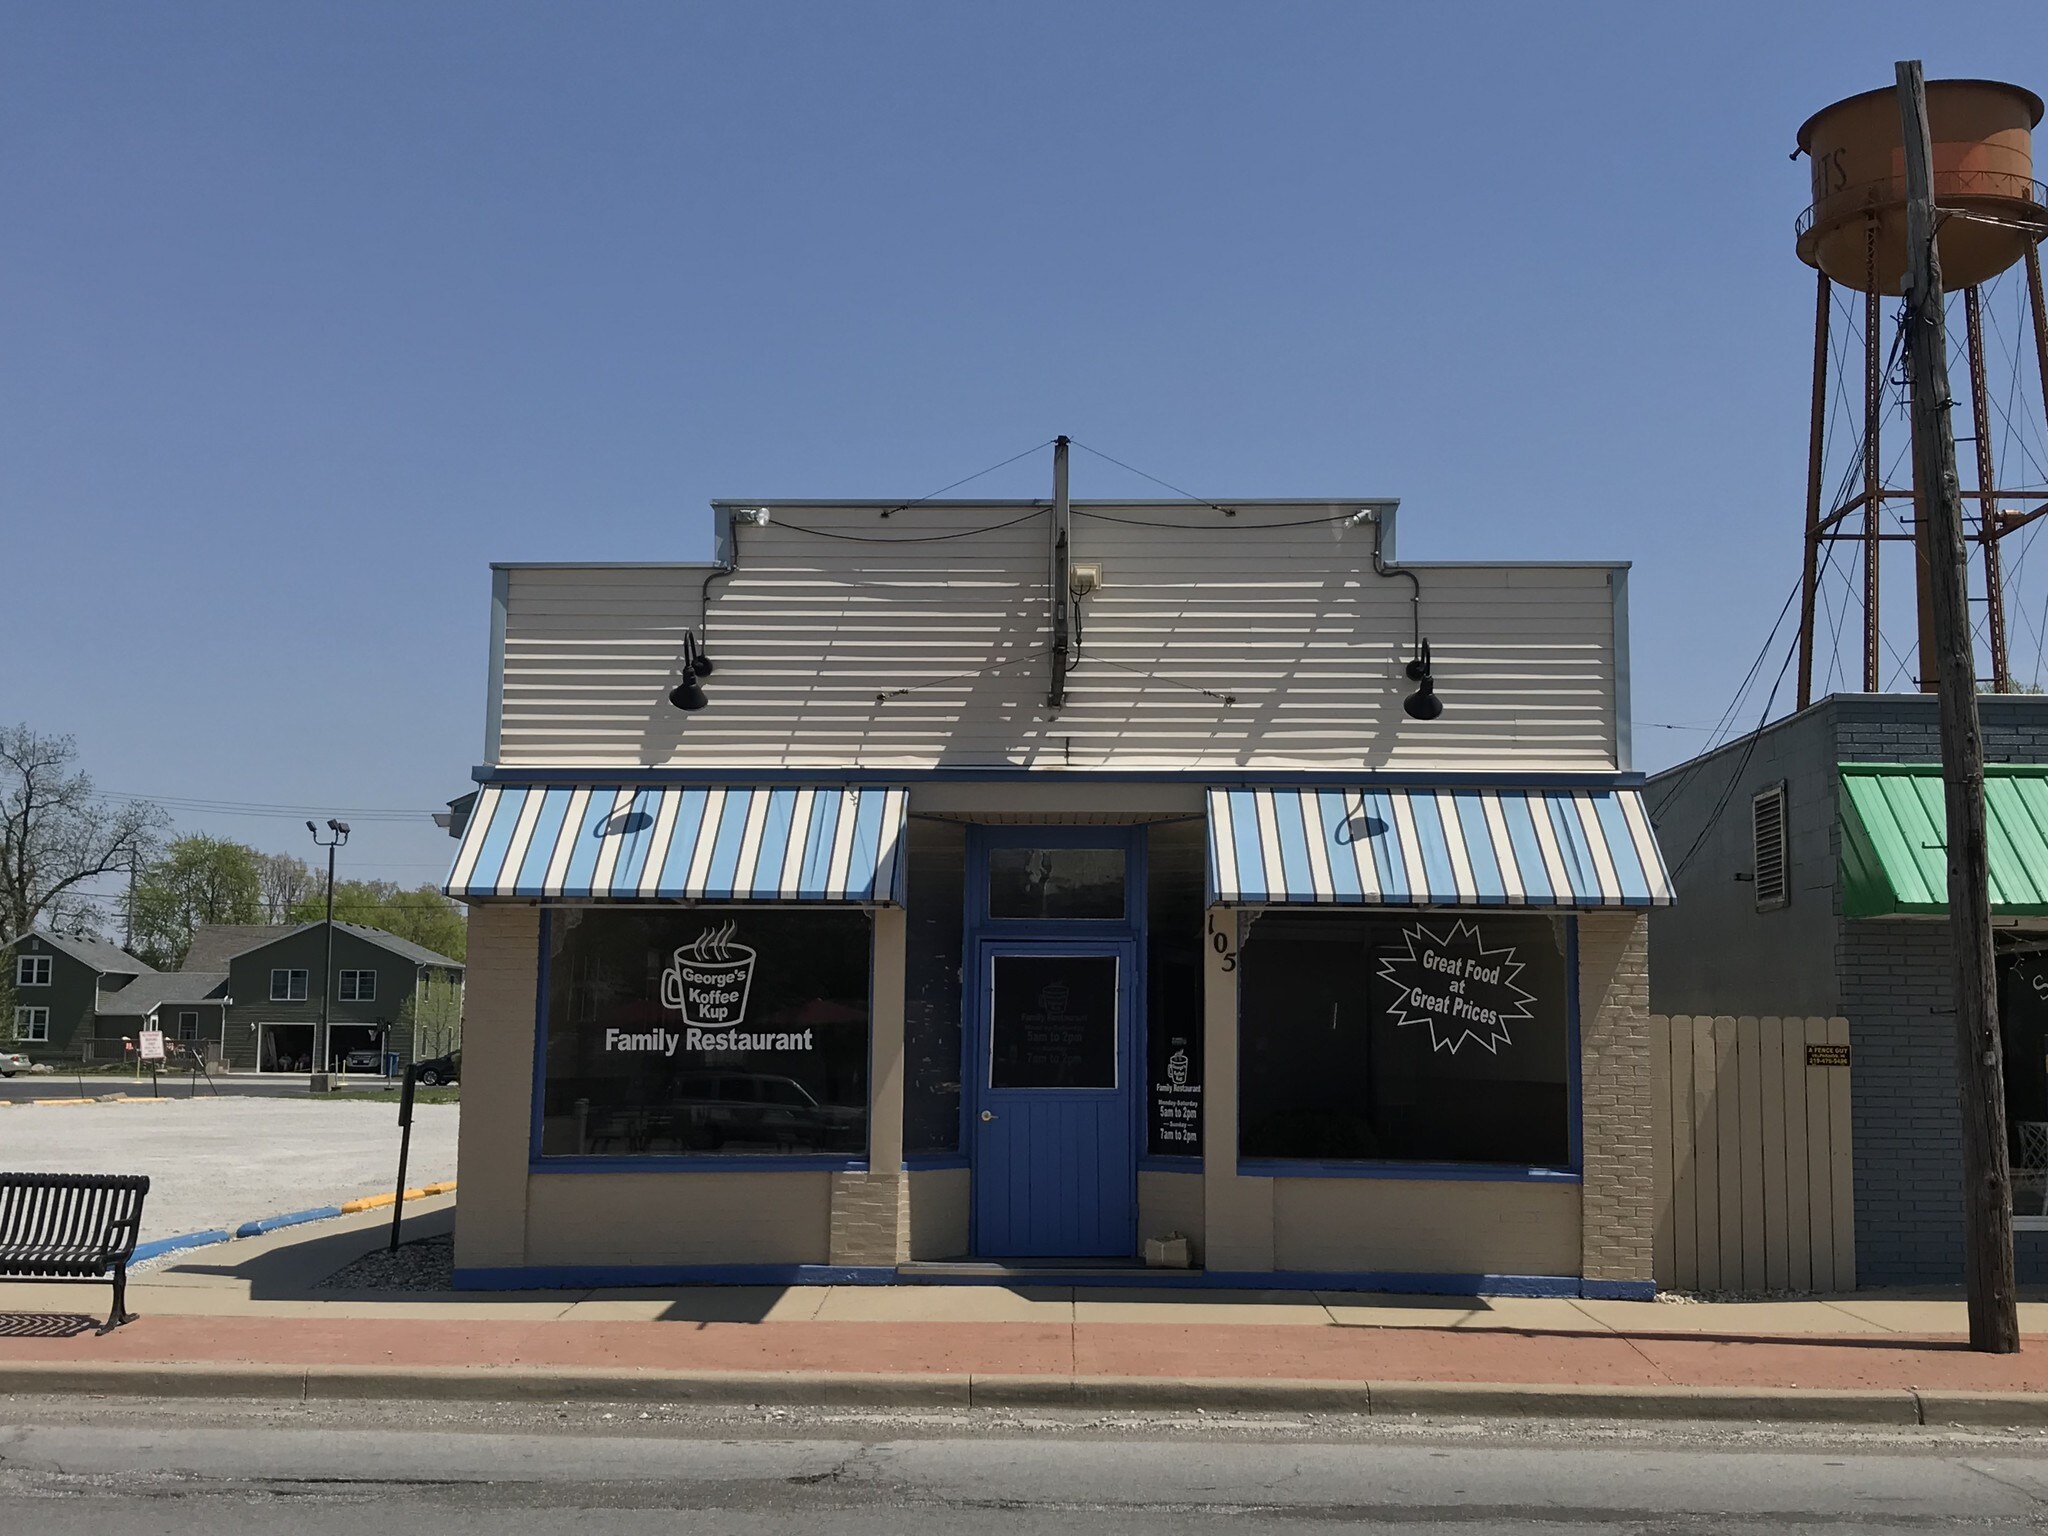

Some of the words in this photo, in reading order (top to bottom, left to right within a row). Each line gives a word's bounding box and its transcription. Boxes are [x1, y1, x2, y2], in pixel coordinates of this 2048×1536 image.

[1208, 914, 1236, 972] 105
[1423, 950, 1462, 976] Great
[1464, 959, 1500, 984] Food
[682, 968, 746, 987] George's
[1449, 980, 1466, 994] at
[688, 988, 739, 1004] Koffee
[699, 1004, 728, 1021] Kup
[1411, 987, 1450, 1014] Great
[1452, 997, 1497, 1025] Prices
[605, 1028, 679, 1056] Family
[686, 1028, 812, 1051] Restaurant
[1156, 1083, 1172, 1093] Family
[1173, 1083, 1201, 1093] Restaurant
[1160, 1106, 1173, 1117] 5am
[1175, 1106, 1181, 1118] to
[1183, 1107, 1197, 1120] 2pm
[1160, 1128, 1173, 1140] 7am
[1175, 1129, 1181, 1140] to
[1183, 1129, 1197, 1143] 2pm
